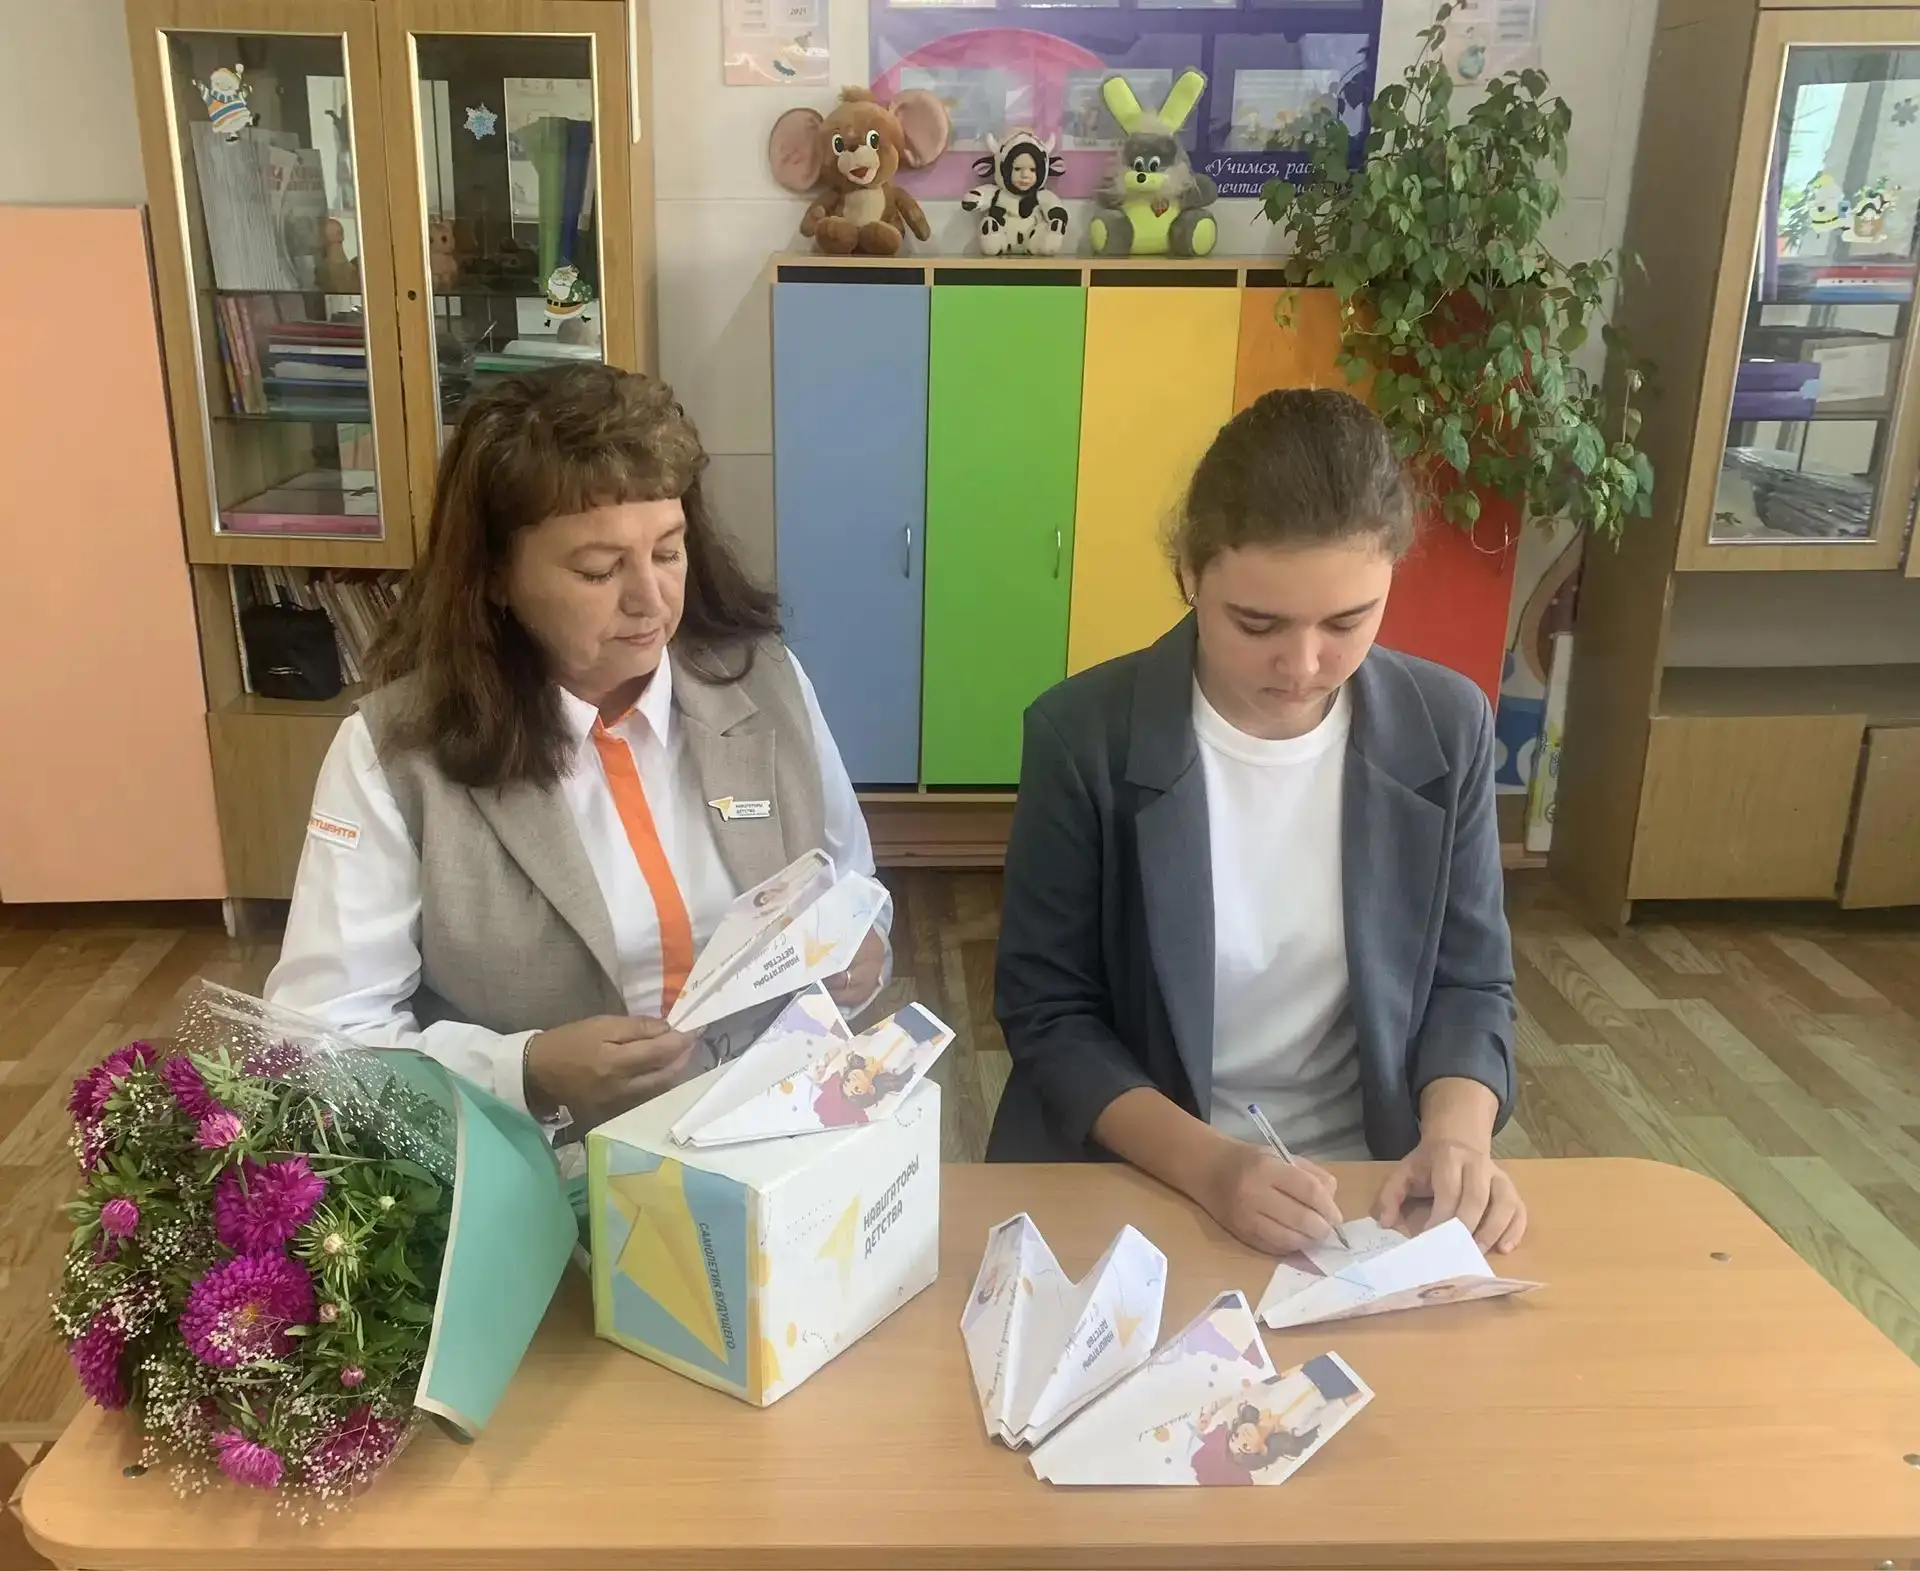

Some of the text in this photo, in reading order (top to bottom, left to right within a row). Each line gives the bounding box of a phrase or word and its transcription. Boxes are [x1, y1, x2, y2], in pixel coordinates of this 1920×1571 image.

[1204, 157, 1280, 177] «Учимся,
[753, 954, 801, 990] НАВИГАТОРЫ
[763, 945, 796, 971] ДЕТСТВА
[863, 1152, 919, 1232] НАВИГАТОРЫ
[864, 1199, 903, 1260] ДЕТСТВА
[699, 1222, 736, 1350] САМОЛЕТИК БУДУЩЕГО
